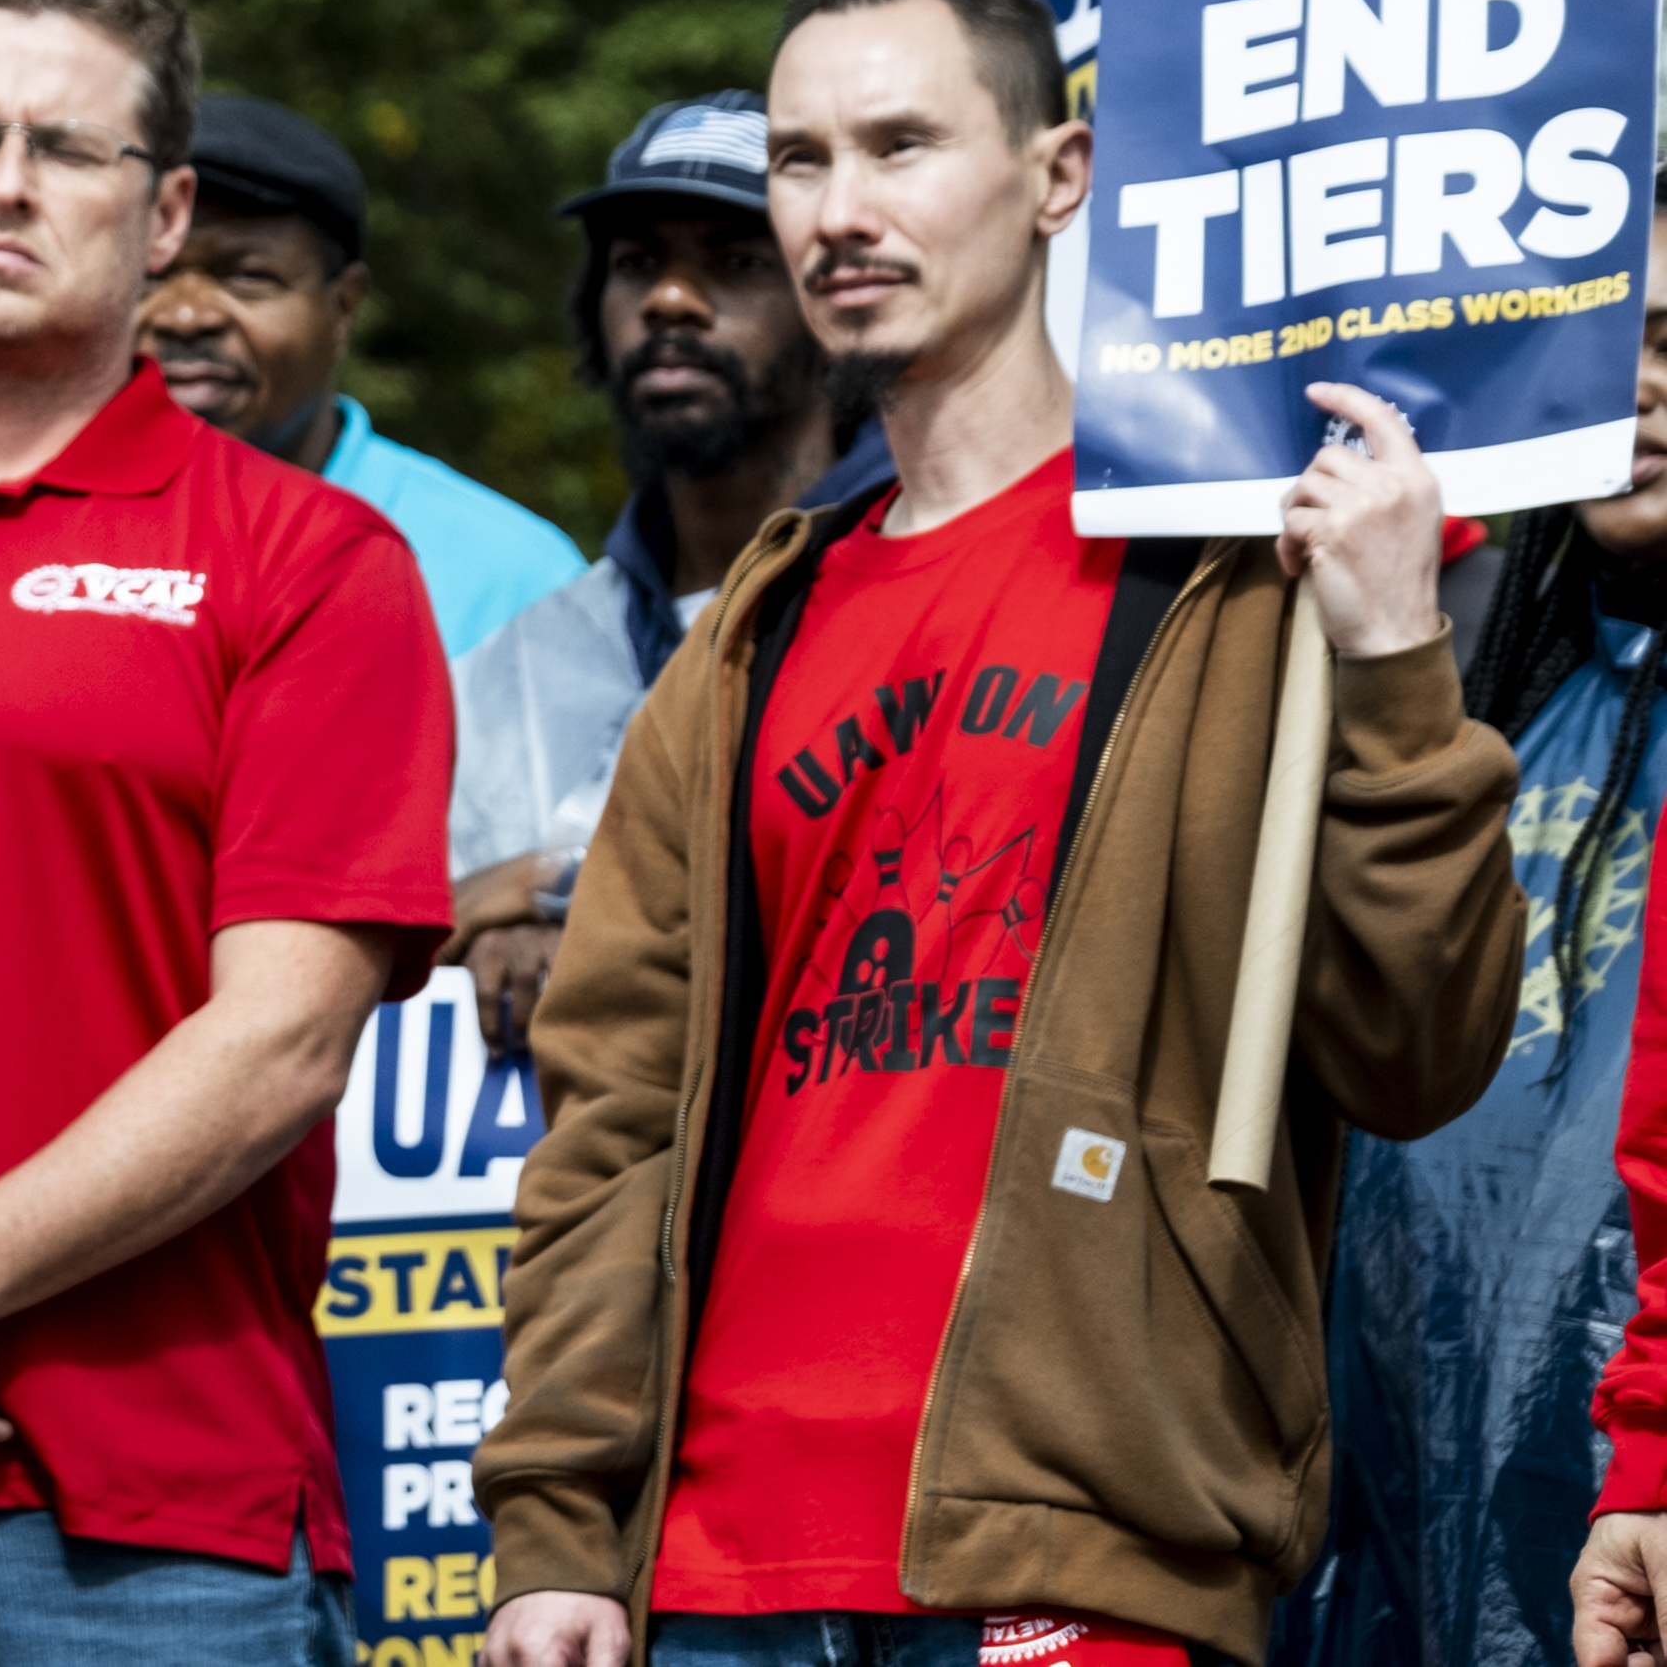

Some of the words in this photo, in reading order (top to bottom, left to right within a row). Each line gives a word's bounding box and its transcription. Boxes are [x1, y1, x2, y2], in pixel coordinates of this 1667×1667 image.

[1118, 106, 1631, 319] TIERS
[1099, 342, 1163, 375] NO
[1169, 331, 1273, 370] MORE
[1278, 316, 1333, 357] 2ND
[1336, 297, 1455, 341] CLASS
[1461, 270, 1631, 325] WORKERS
[776, 670, 945, 820] UAW
[959, 664, 1088, 747] ON
[373, 1002, 548, 1179] UA
[783, 977, 1021, 1097] STRIKE
[326, 1244, 511, 1320] STA
